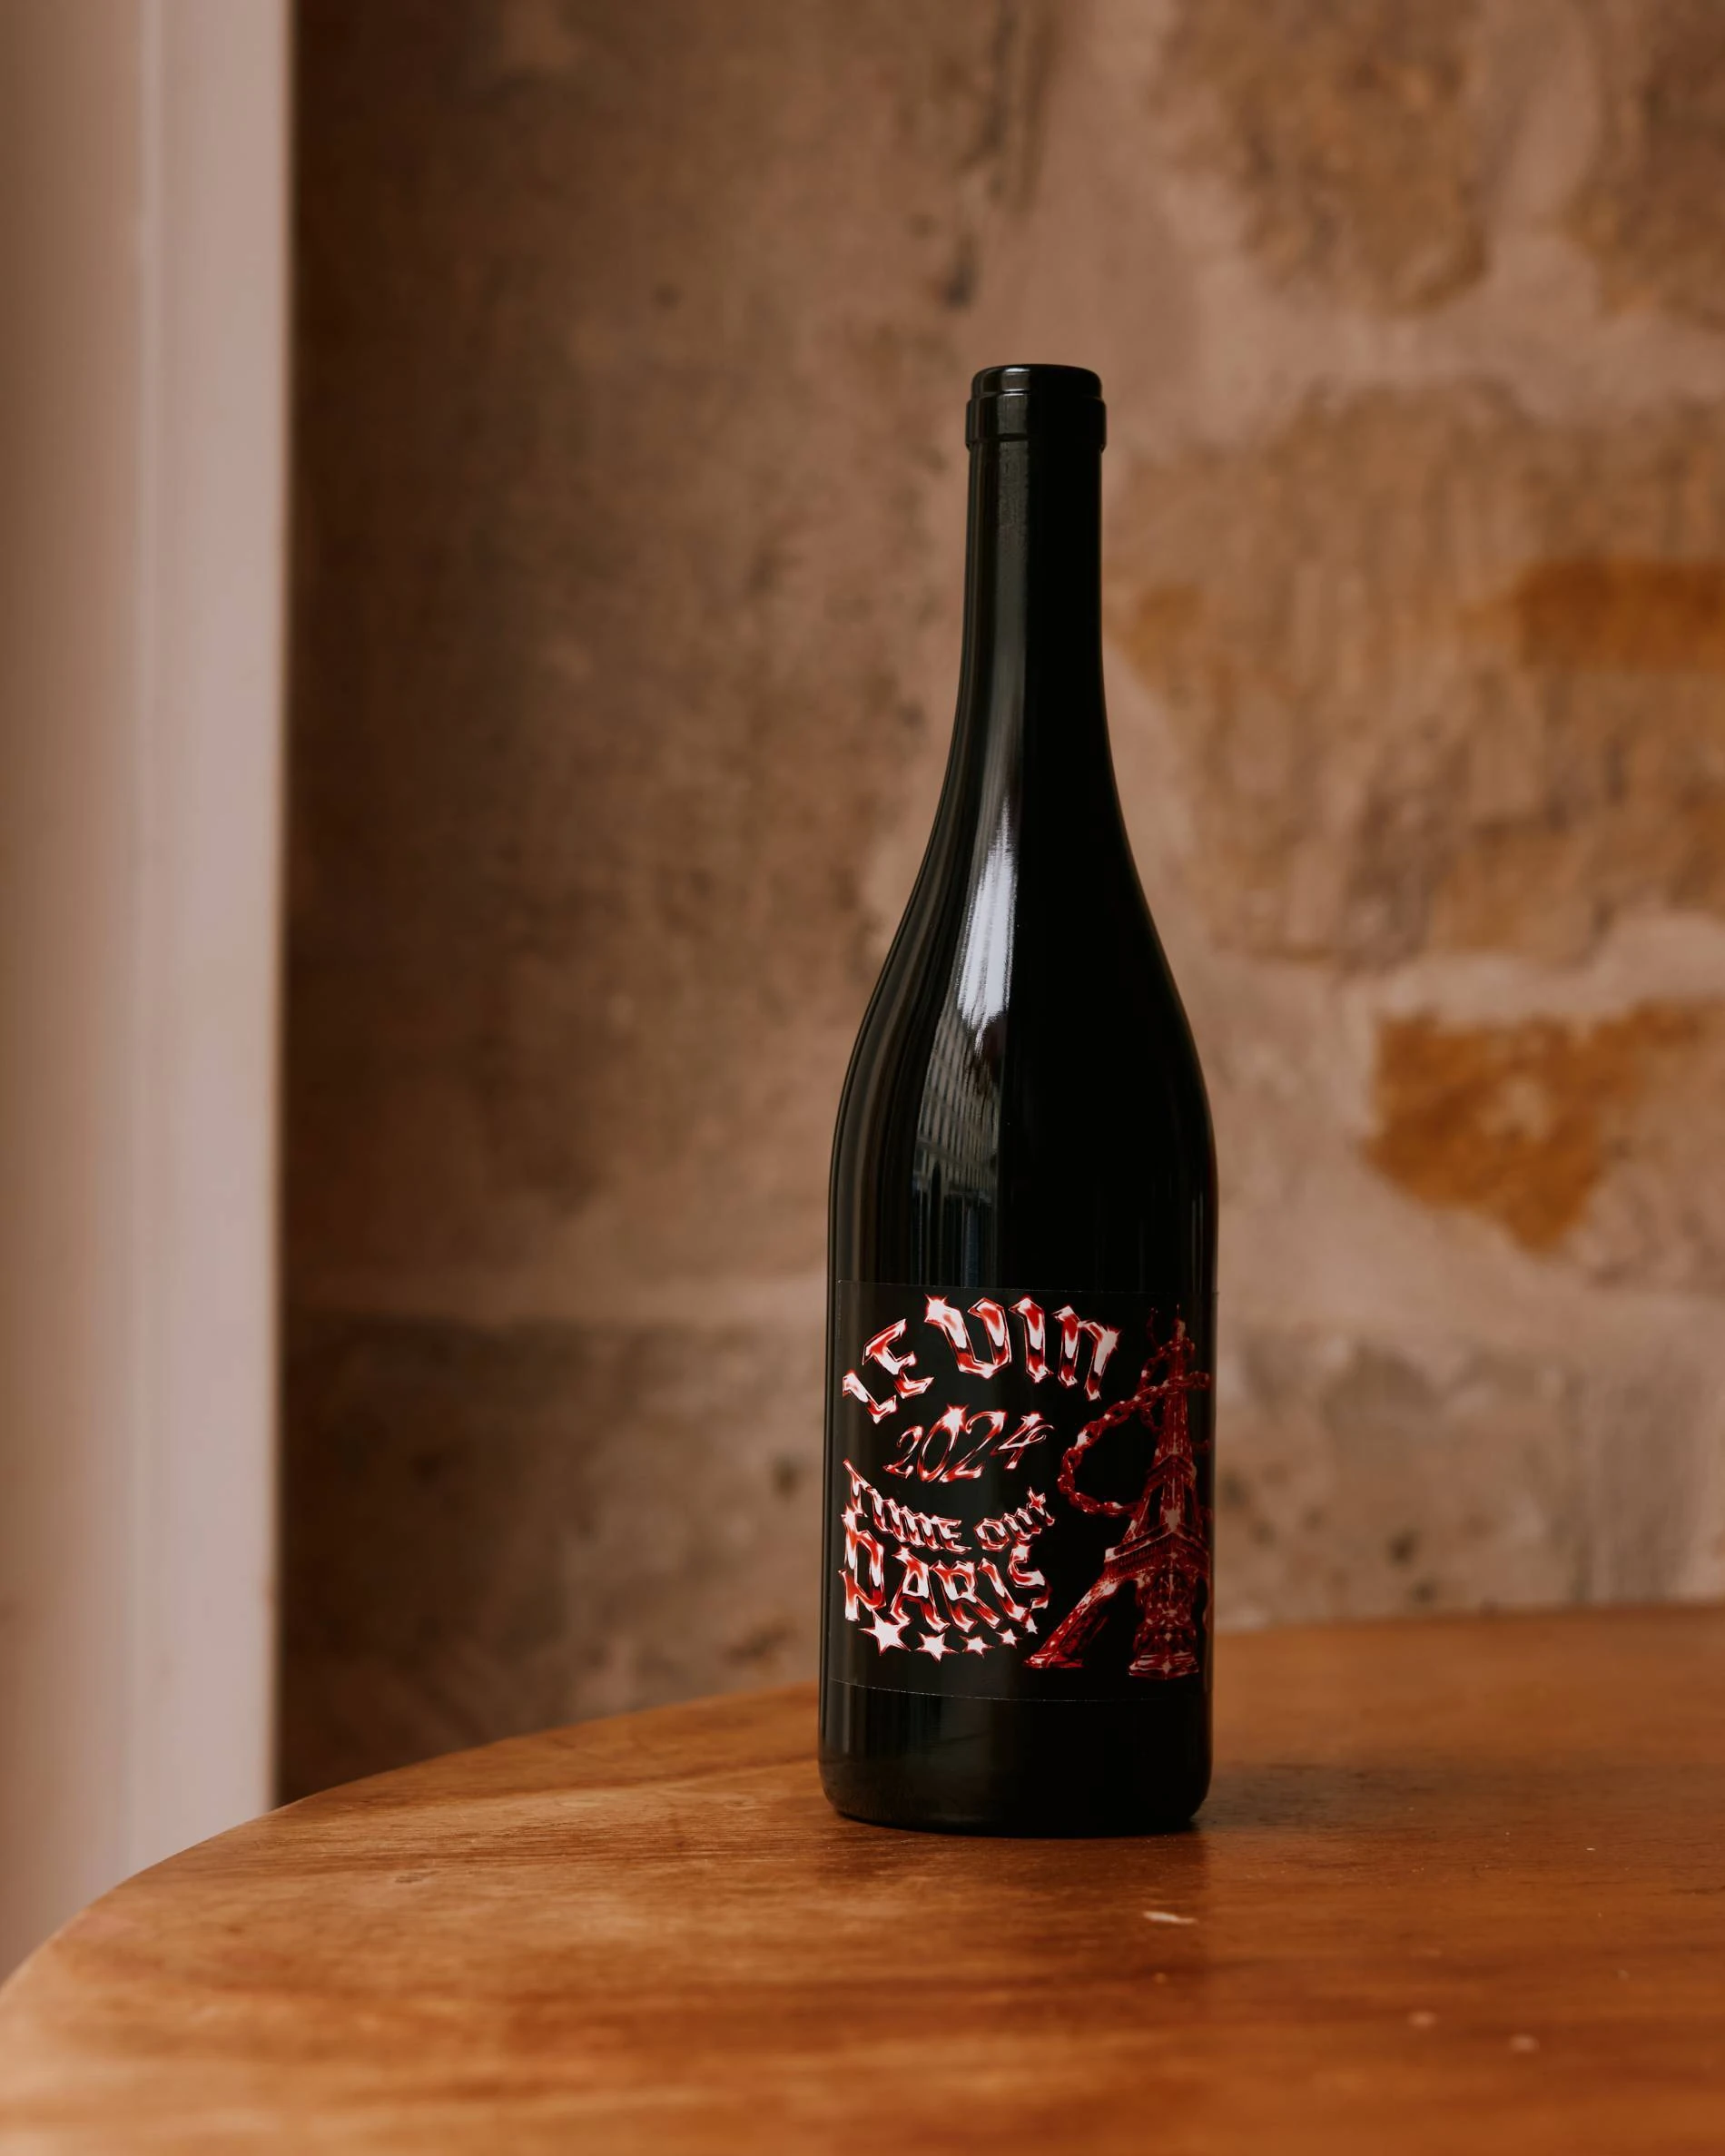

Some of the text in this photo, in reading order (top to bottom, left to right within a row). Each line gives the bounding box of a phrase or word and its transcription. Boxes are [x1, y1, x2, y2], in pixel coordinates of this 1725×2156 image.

[843, 1318, 934, 1423] LE
[882, 1404, 1054, 1482] 2024
[838, 1503, 1053, 1633] PARIS
